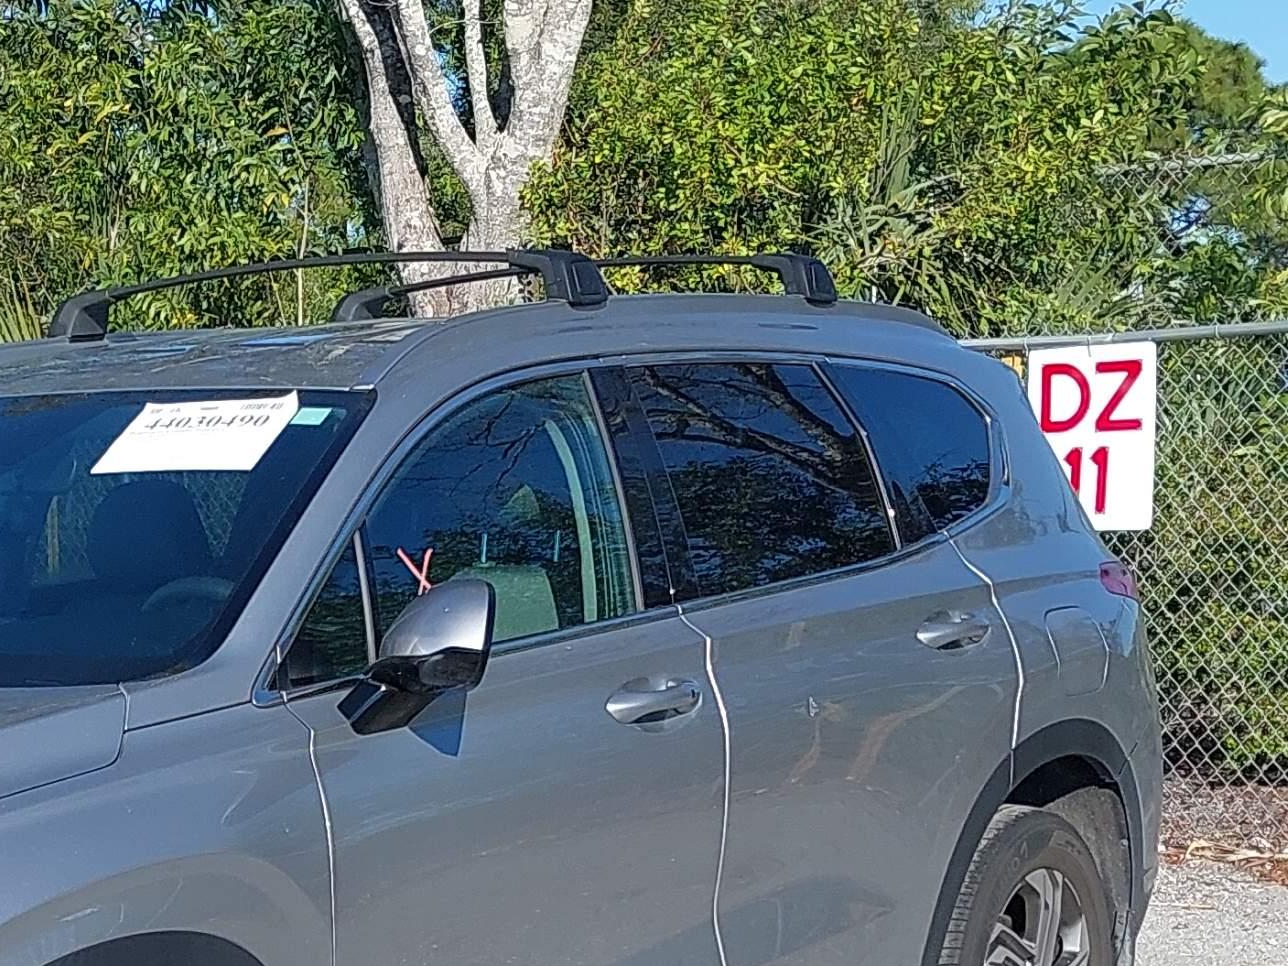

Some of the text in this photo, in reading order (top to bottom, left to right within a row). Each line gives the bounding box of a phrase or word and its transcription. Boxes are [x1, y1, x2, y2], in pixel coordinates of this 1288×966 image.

[145, 414, 271, 430] 44030490
[1039, 359, 1143, 433] DZ
[1063, 446, 1110, 514] 11
